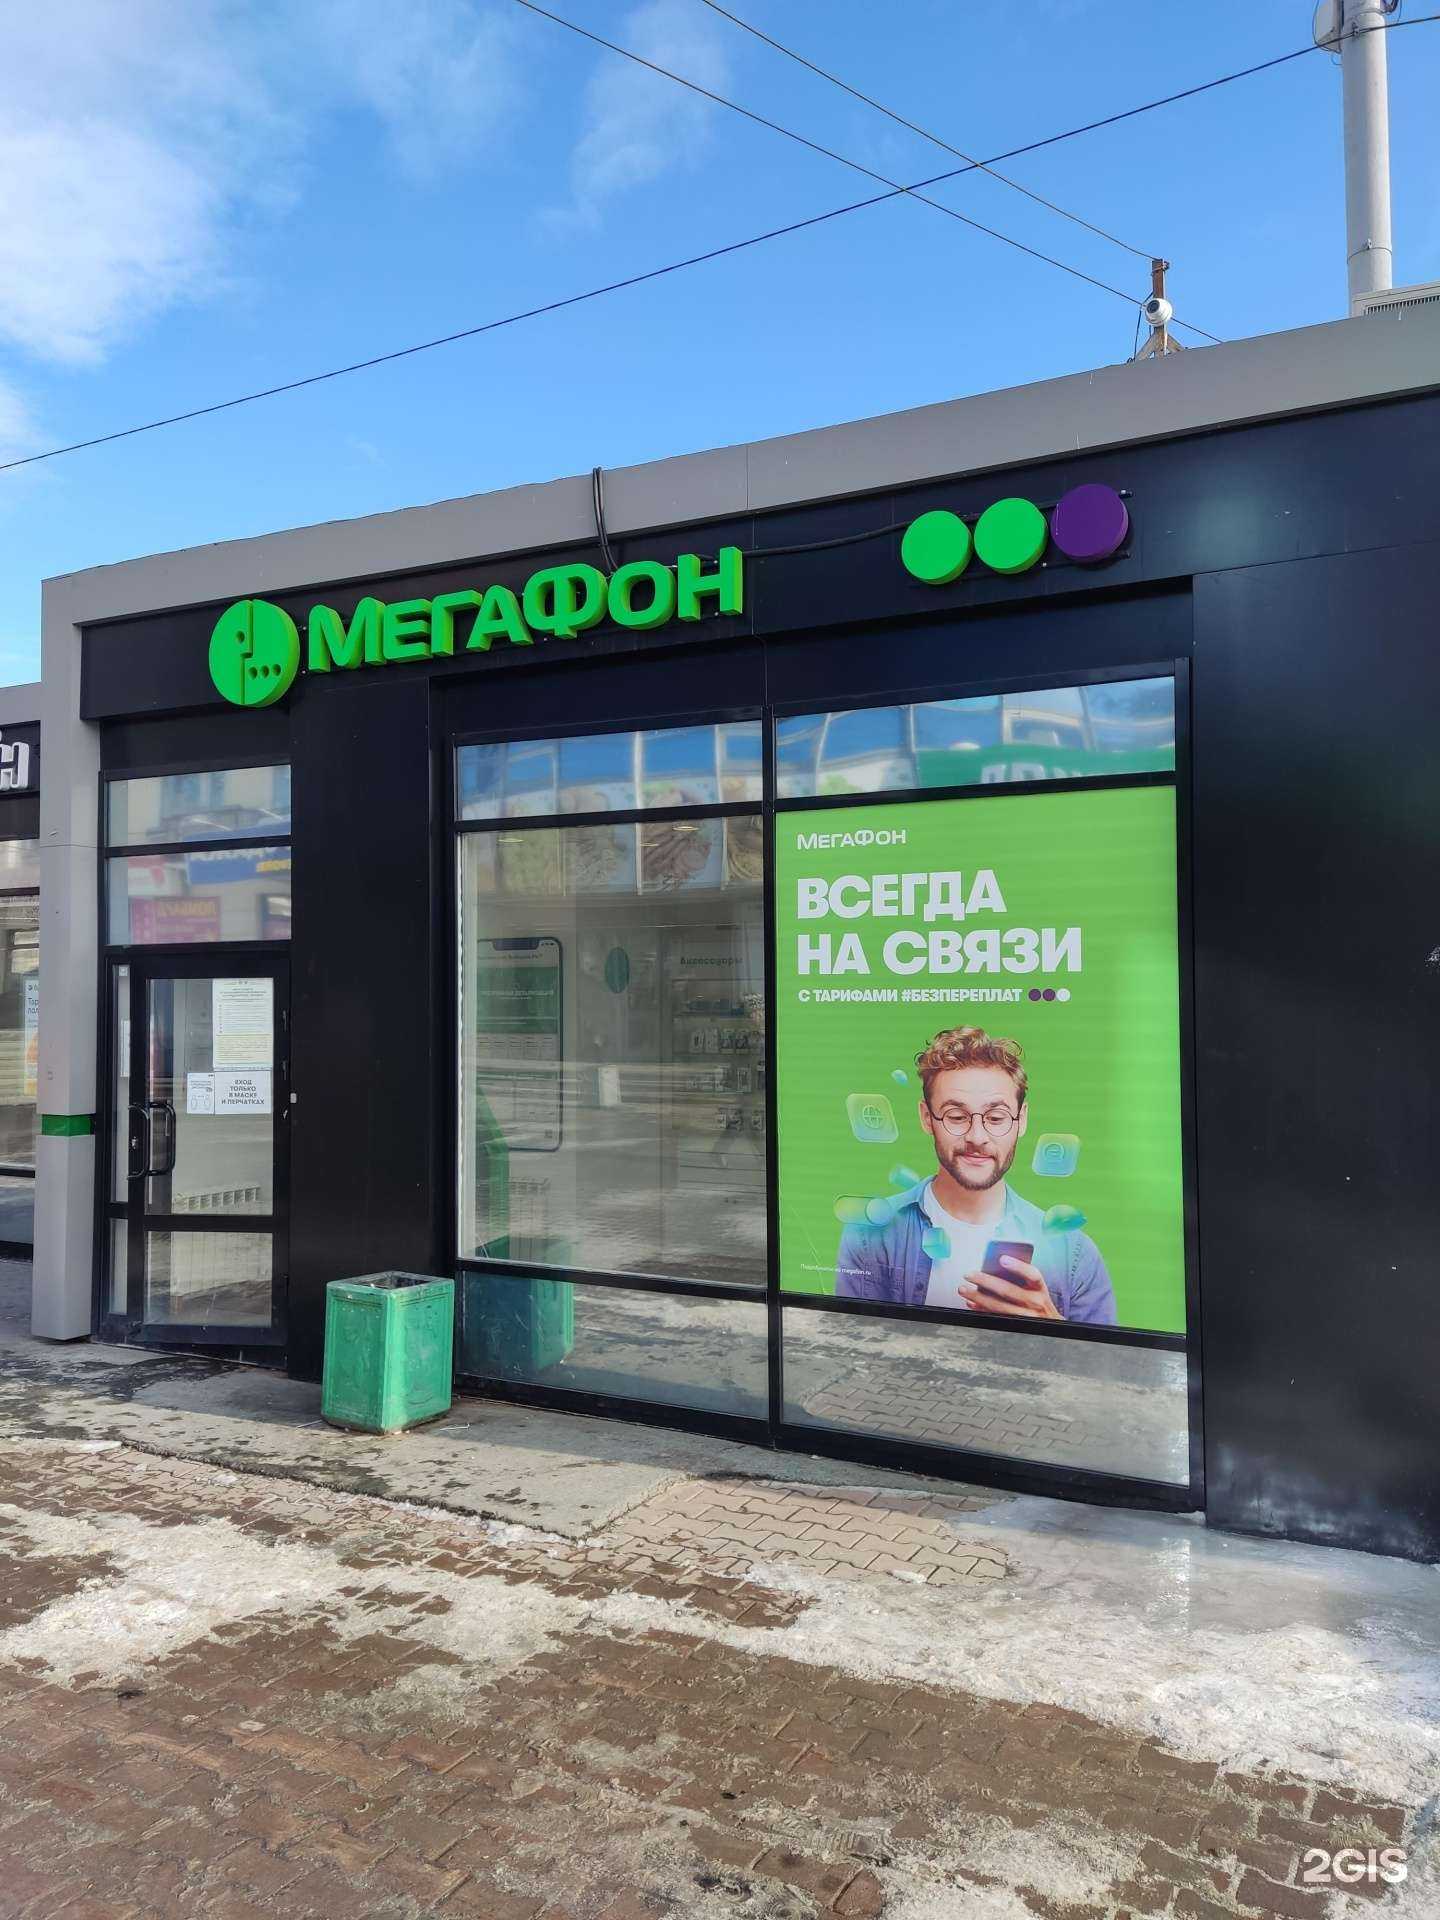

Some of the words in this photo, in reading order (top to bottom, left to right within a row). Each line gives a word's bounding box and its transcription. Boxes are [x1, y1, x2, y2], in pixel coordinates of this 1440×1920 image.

[797, 869, 1008, 922] ВСЕГДА
[797, 932, 871, 975] НА
[882, 927, 1083, 976] СВЯЗИ
[798, 989, 811, 1002] С
[812, 988, 898, 1002] ТАРИФАМИ
[901, 987, 1023, 1003] #БЕЗПЕРЕПЛАТ
